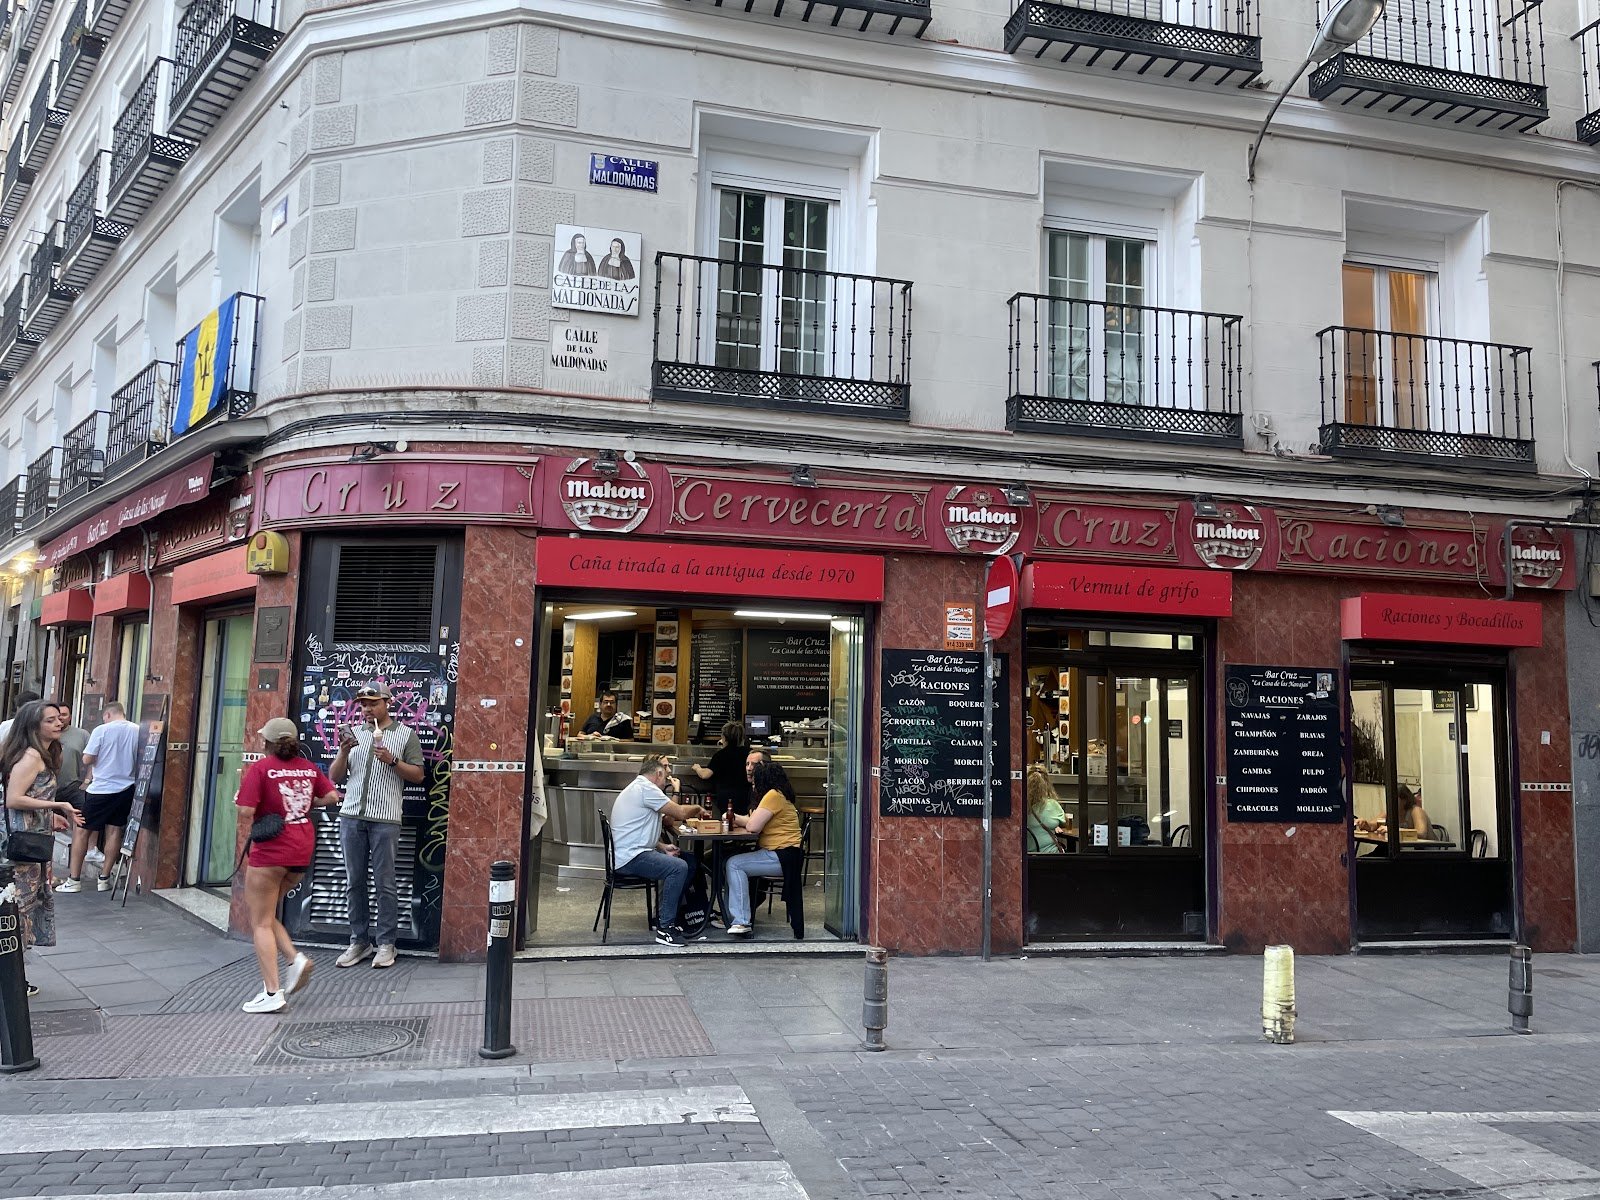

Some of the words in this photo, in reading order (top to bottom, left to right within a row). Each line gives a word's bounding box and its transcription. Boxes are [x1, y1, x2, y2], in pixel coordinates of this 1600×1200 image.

[609, 156, 653, 170] CALLE
[623, 165, 637, 173] DE
[591, 169, 655, 190] MALDONADAS
[553, 274, 598, 291] CALLE
[599, 280, 613, 291] DE
[614, 282, 639, 294] LAS
[551, 287, 638, 312] MALDONADAS
[565, 328, 598, 344] CALLE
[566, 344, 577, 353] DE
[579, 345, 594, 354] LAS
[551, 354, 608, 372] MALDONADAS
[302, 470, 461, 513] Cruz
[566, 479, 647, 501] Mahou
[679, 480, 919, 533] Cervecería
[948, 506, 1018, 526] Mahou
[1053, 507, 1161, 548] Cruz
[1195, 522, 1261, 542] Mahou
[1286, 521, 1478, 568] Raciones
[569, 553, 612, 571] Caña
[617, 555, 667, 574] tirada
[671, 564, 681, 575] a
[687, 558, 701, 576] la
[706, 561, 765, 586] antigua
[772, 563, 814, 583] desde
[818, 567, 856, 585] 1970
[1069, 576, 1131, 596] Vermut
[1136, 579, 1155, 597] de
[1159, 580, 1200, 603] grifo
[1381, 608, 1441, 626] Raciones
[1443, 615, 1453, 630] y
[1456, 611, 1524, 630] Bocadillos
[786, 636, 803, 646] Bar
[805, 636, 826, 647] Cruz
[781, 647, 796, 655] Casa
[797, 647, 804, 655] de
[926, 654, 942, 664] Bar
[944, 655, 964, 665] Cruz
[352, 662, 376, 674] Bar
[377, 662, 407, 675] Cruz
[1265, 670, 1278, 679] Bar
[1280, 670, 1298, 680] Cruz
[345, 678, 363, 687] Casa
[920, 681, 970, 691] RACIONES
[1261, 679, 1273, 687] Casa
[1273, 679, 1280, 687] de
[898, 697, 926, 706] CAZÓN
[1259, 695, 1304, 704] RACIONES
[1240, 712, 1271, 720] NAVAJAS
[1296, 713, 1327, 721] ZARAJOS
[888, 718, 935, 726] CROQUETAS
[1234, 729, 1277, 738] CHAMPIÑÓN
[892, 737, 932, 746] TORTILLA
[1233, 748, 1279, 757] ZAMBURIÑAS
[1301, 750, 1324, 758] OREJA
[894, 757, 929, 765] MORUNO
[1302, 768, 1325, 776] PULPO
[898, 776, 925, 785] LACÓN
[1236, 786, 1279, 794] CHIPIRONES
[1300, 786, 1328, 794] PADRÓN
[1236, 804, 1279, 812] CARACOLES
[1296, 805, 1333, 813] MOLLEJAS
